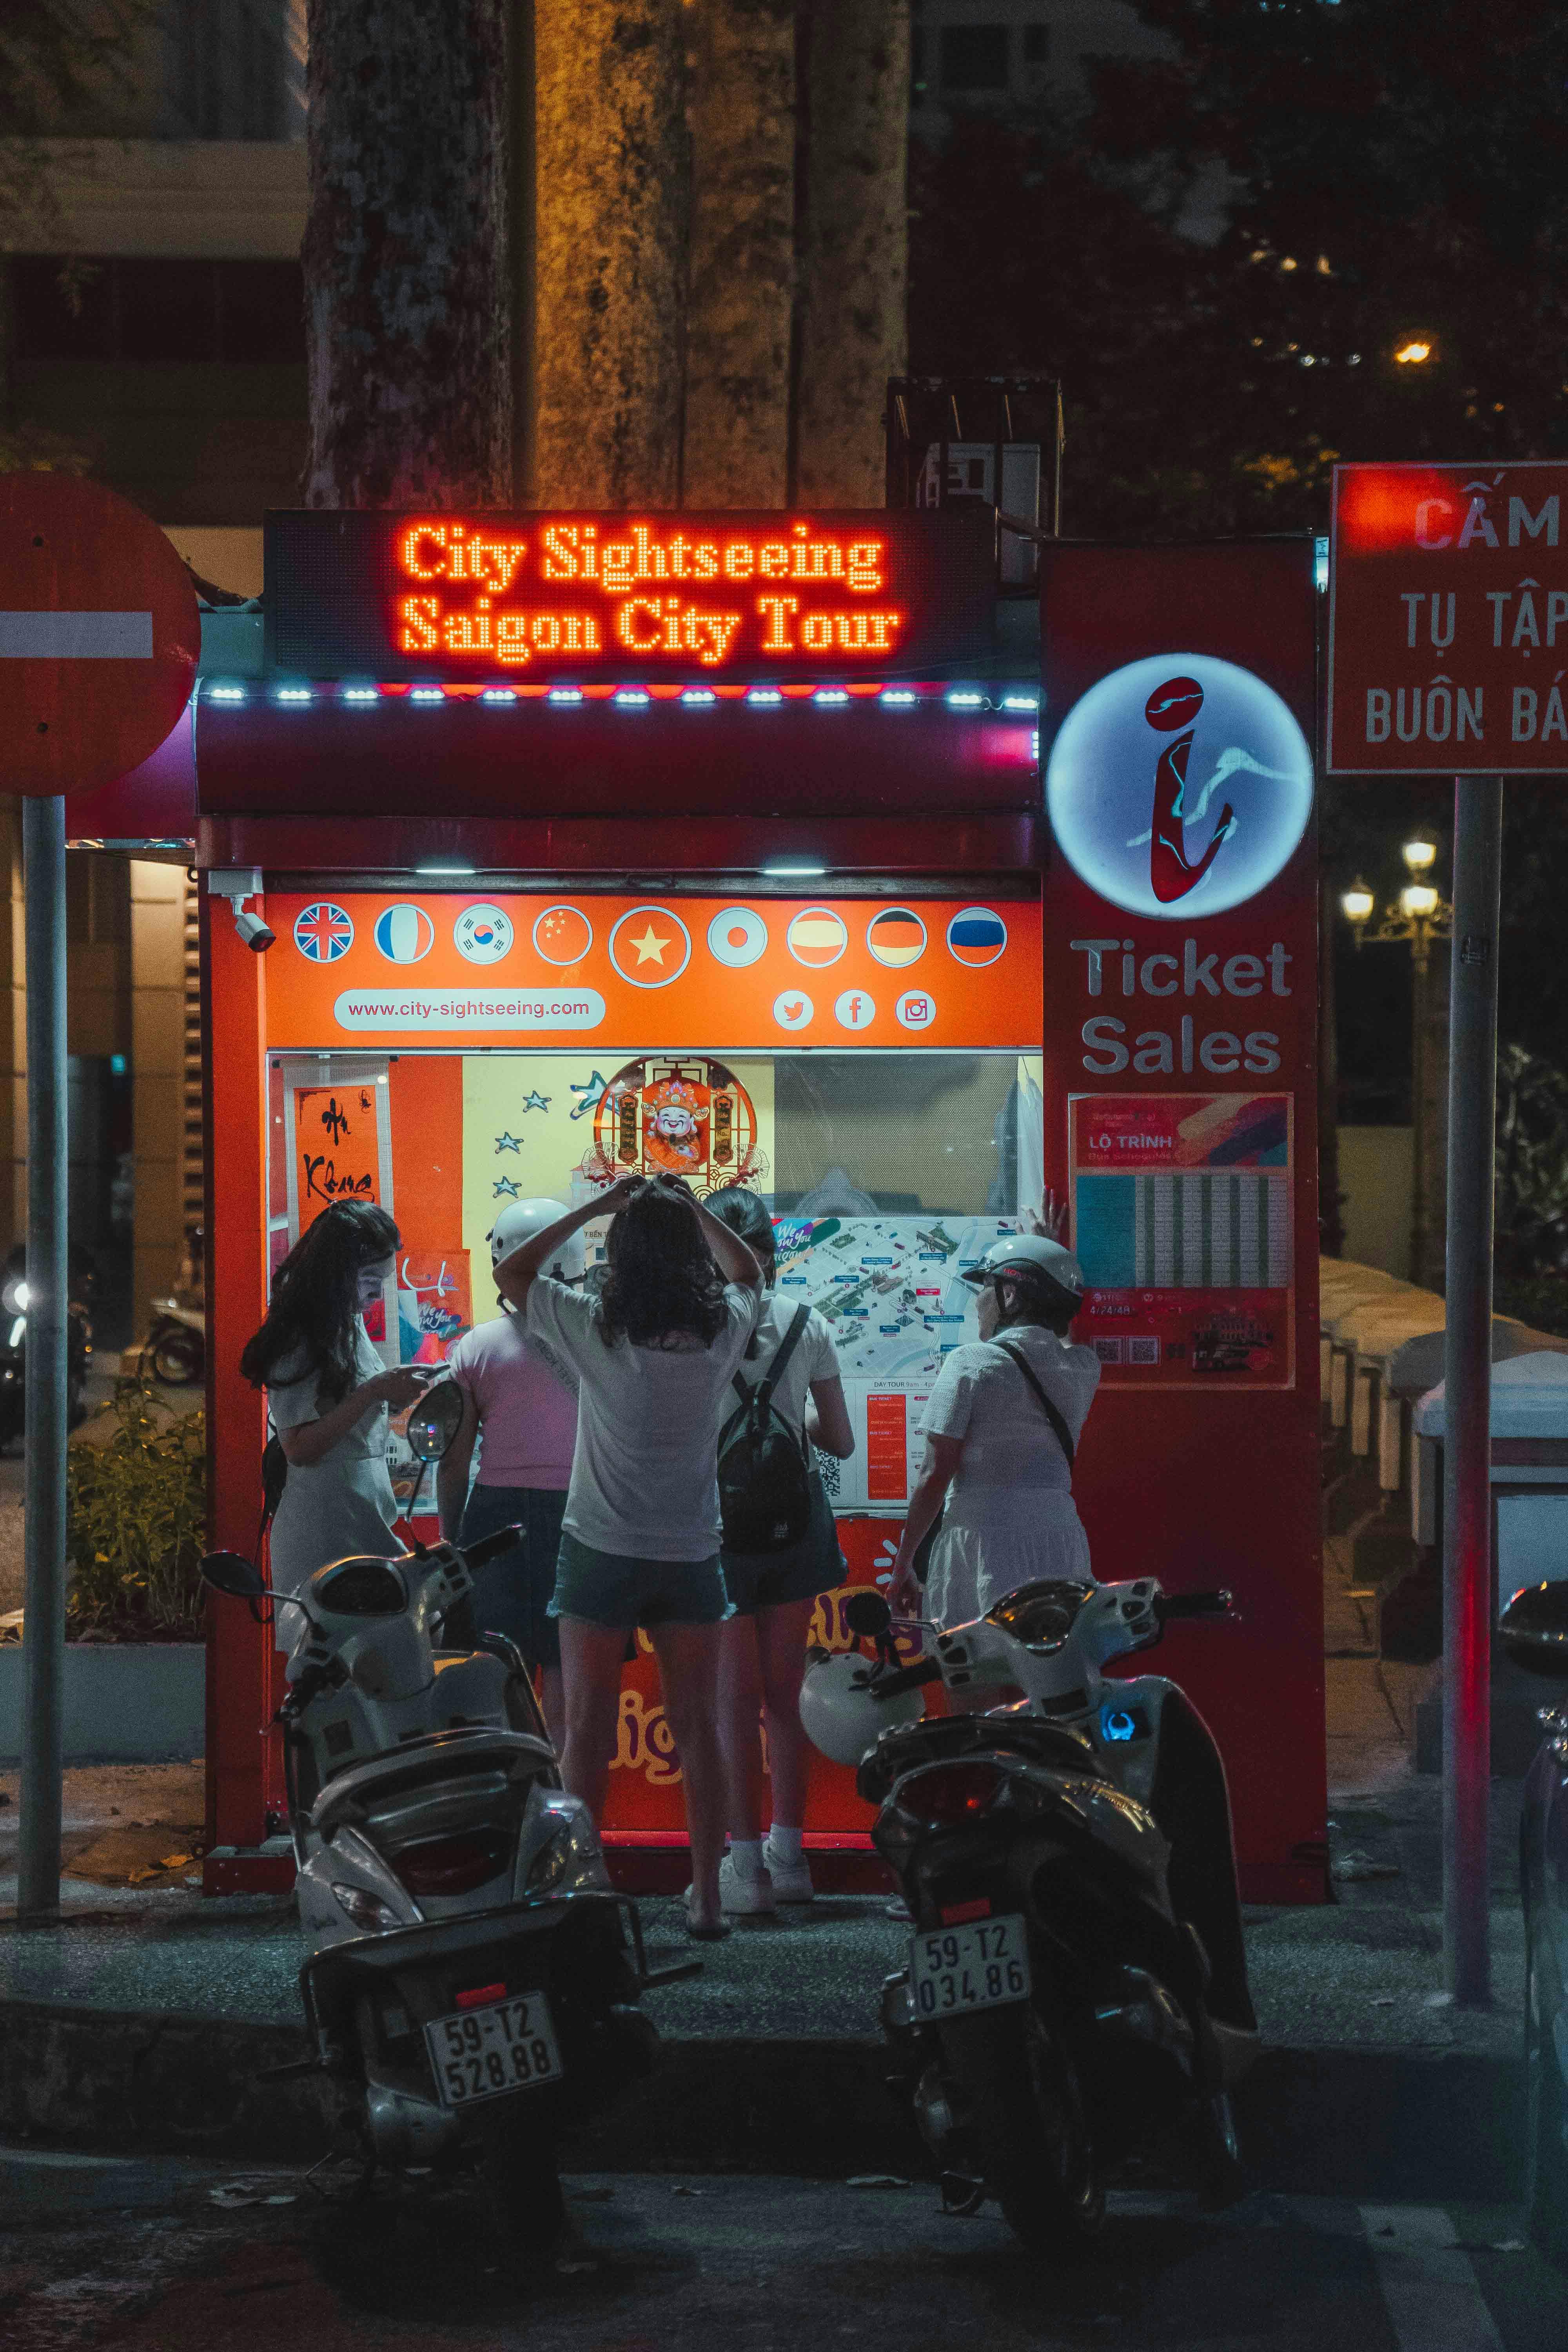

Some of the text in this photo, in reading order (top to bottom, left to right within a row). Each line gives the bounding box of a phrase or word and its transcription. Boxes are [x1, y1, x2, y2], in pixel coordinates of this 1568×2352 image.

[1415, 473, 1560, 550] CẤM
[404, 524, 883, 591] City Sightseeing
[402, 598, 900, 664] Saigon City Tour
[1401, 578, 1568, 657] TỤ TẬP
[1367, 675, 1484, 742] BUÔN
[1070, 938, 1292, 996] Ticket
[348, 1001, 589, 1018] www.city-sightseeing.com
[1082, 1015, 1281, 1074] Sales
[1089, 1132, 1173, 1151] LỘ TRÌNH
[778, 1223, 797, 1238] We
[927, 1925, 1010, 1971] 59-T2
[445, 2002, 534, 2058] 59-T2
